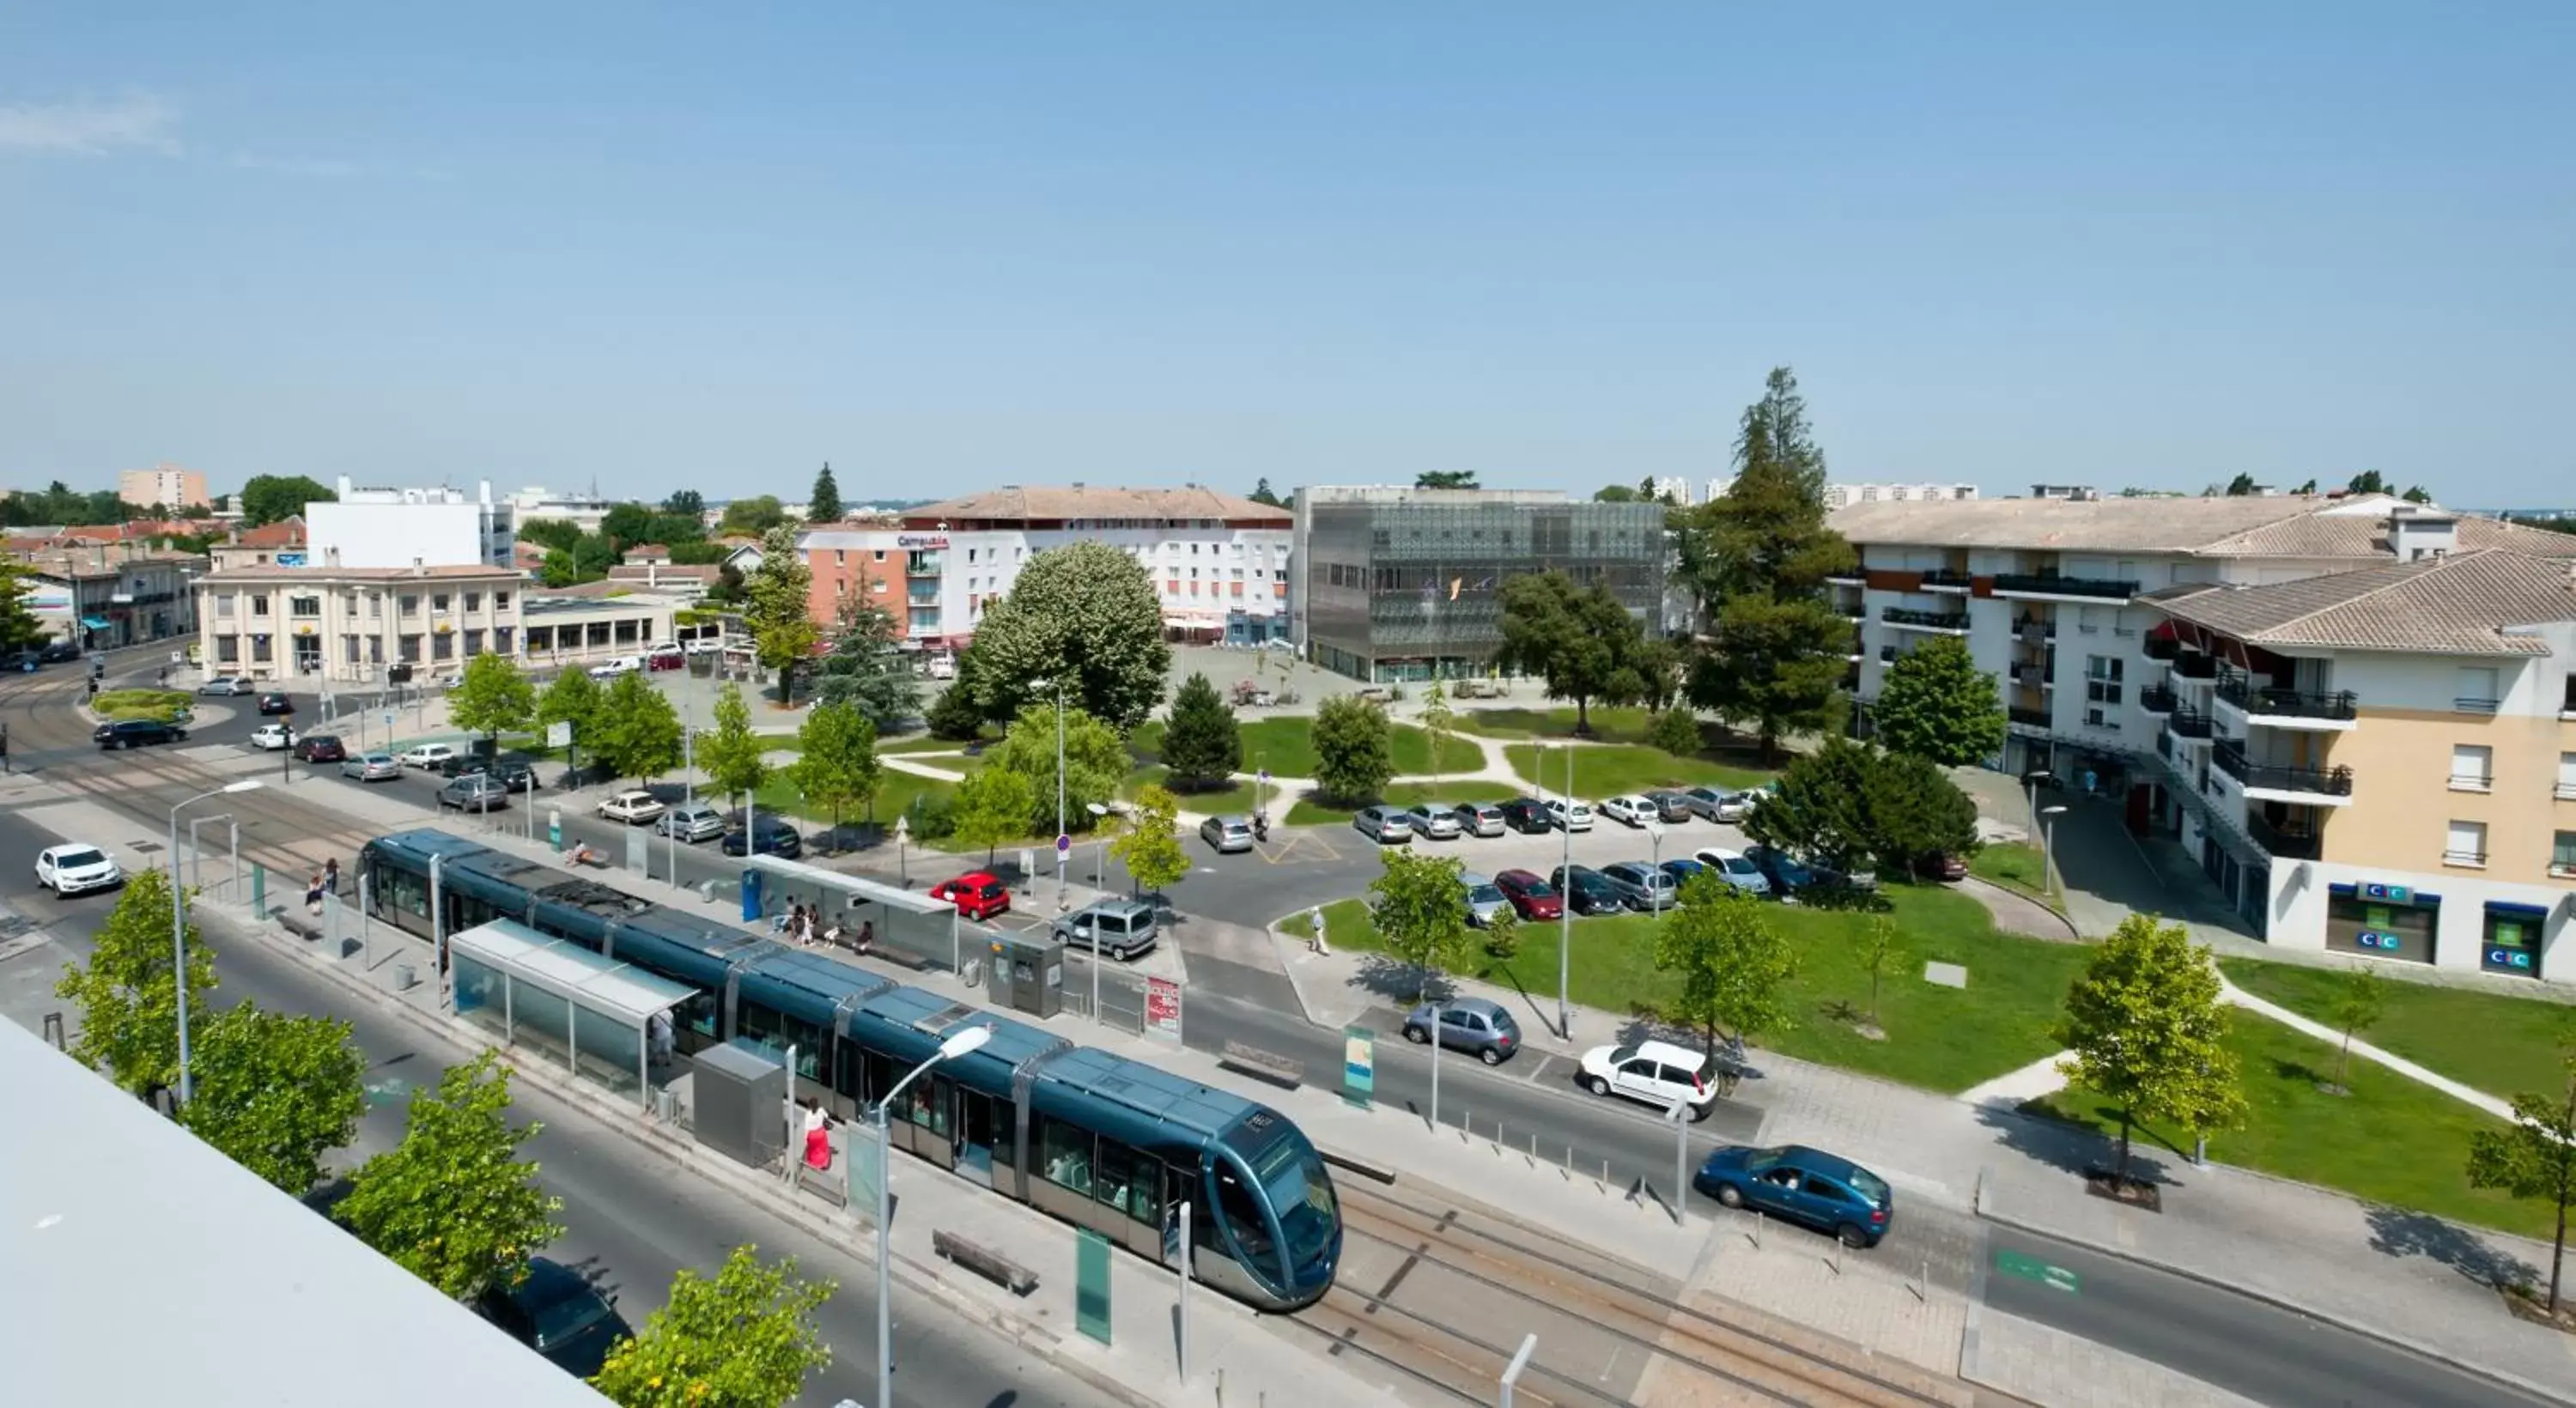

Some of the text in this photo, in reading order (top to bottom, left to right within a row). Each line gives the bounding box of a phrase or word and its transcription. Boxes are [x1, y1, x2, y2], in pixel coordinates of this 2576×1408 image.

[2369, 884, 2403, 898] CIC
[2361, 932, 2396, 948] CIC
[2491, 950, 2529, 967] CIC
